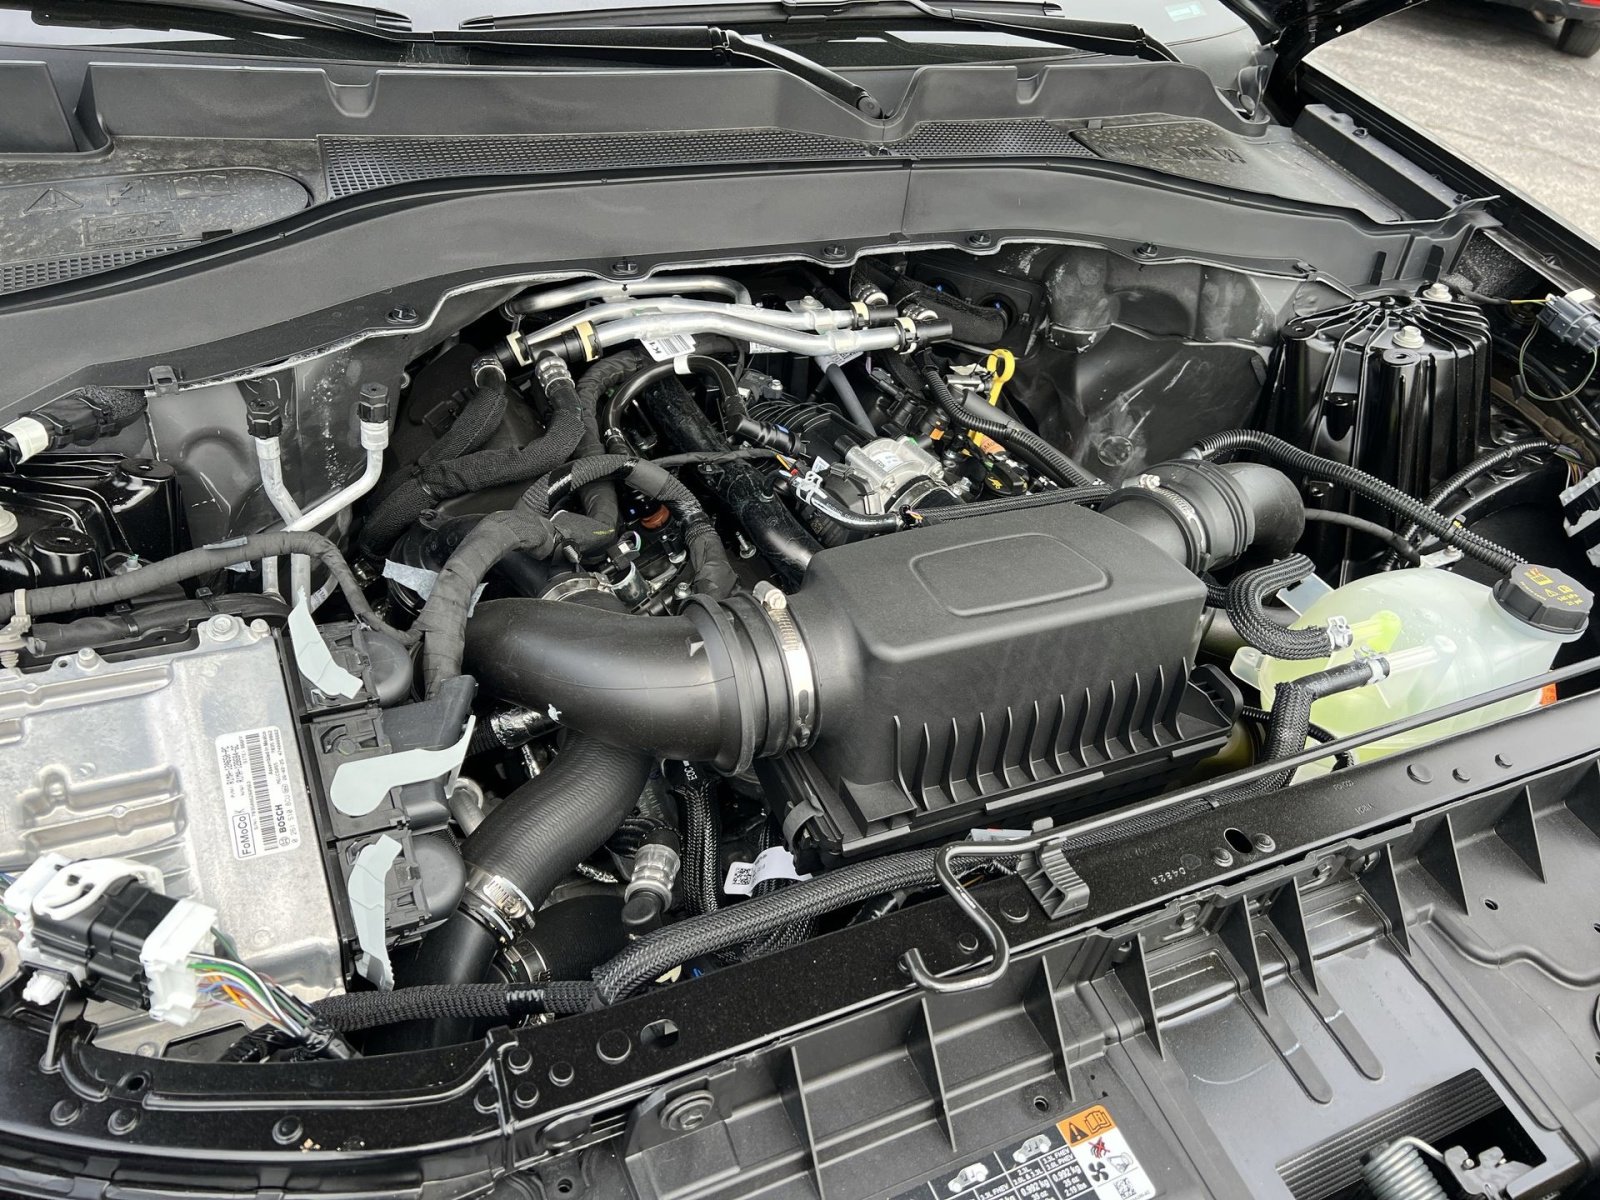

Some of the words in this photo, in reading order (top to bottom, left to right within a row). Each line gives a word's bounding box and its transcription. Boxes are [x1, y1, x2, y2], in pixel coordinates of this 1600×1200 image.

[274, 804, 287, 834] BOSCH
[237, 815, 252, 855] FoMoCo
[1052, 1170, 1070, 1182] 0.992
[1070, 1165, 1082, 1176] kg
[992, 1183, 1009, 1195] FHEV
[1020, 1183, 1040, 1196] 0.992
[1040, 1179, 1051, 1189] kg
